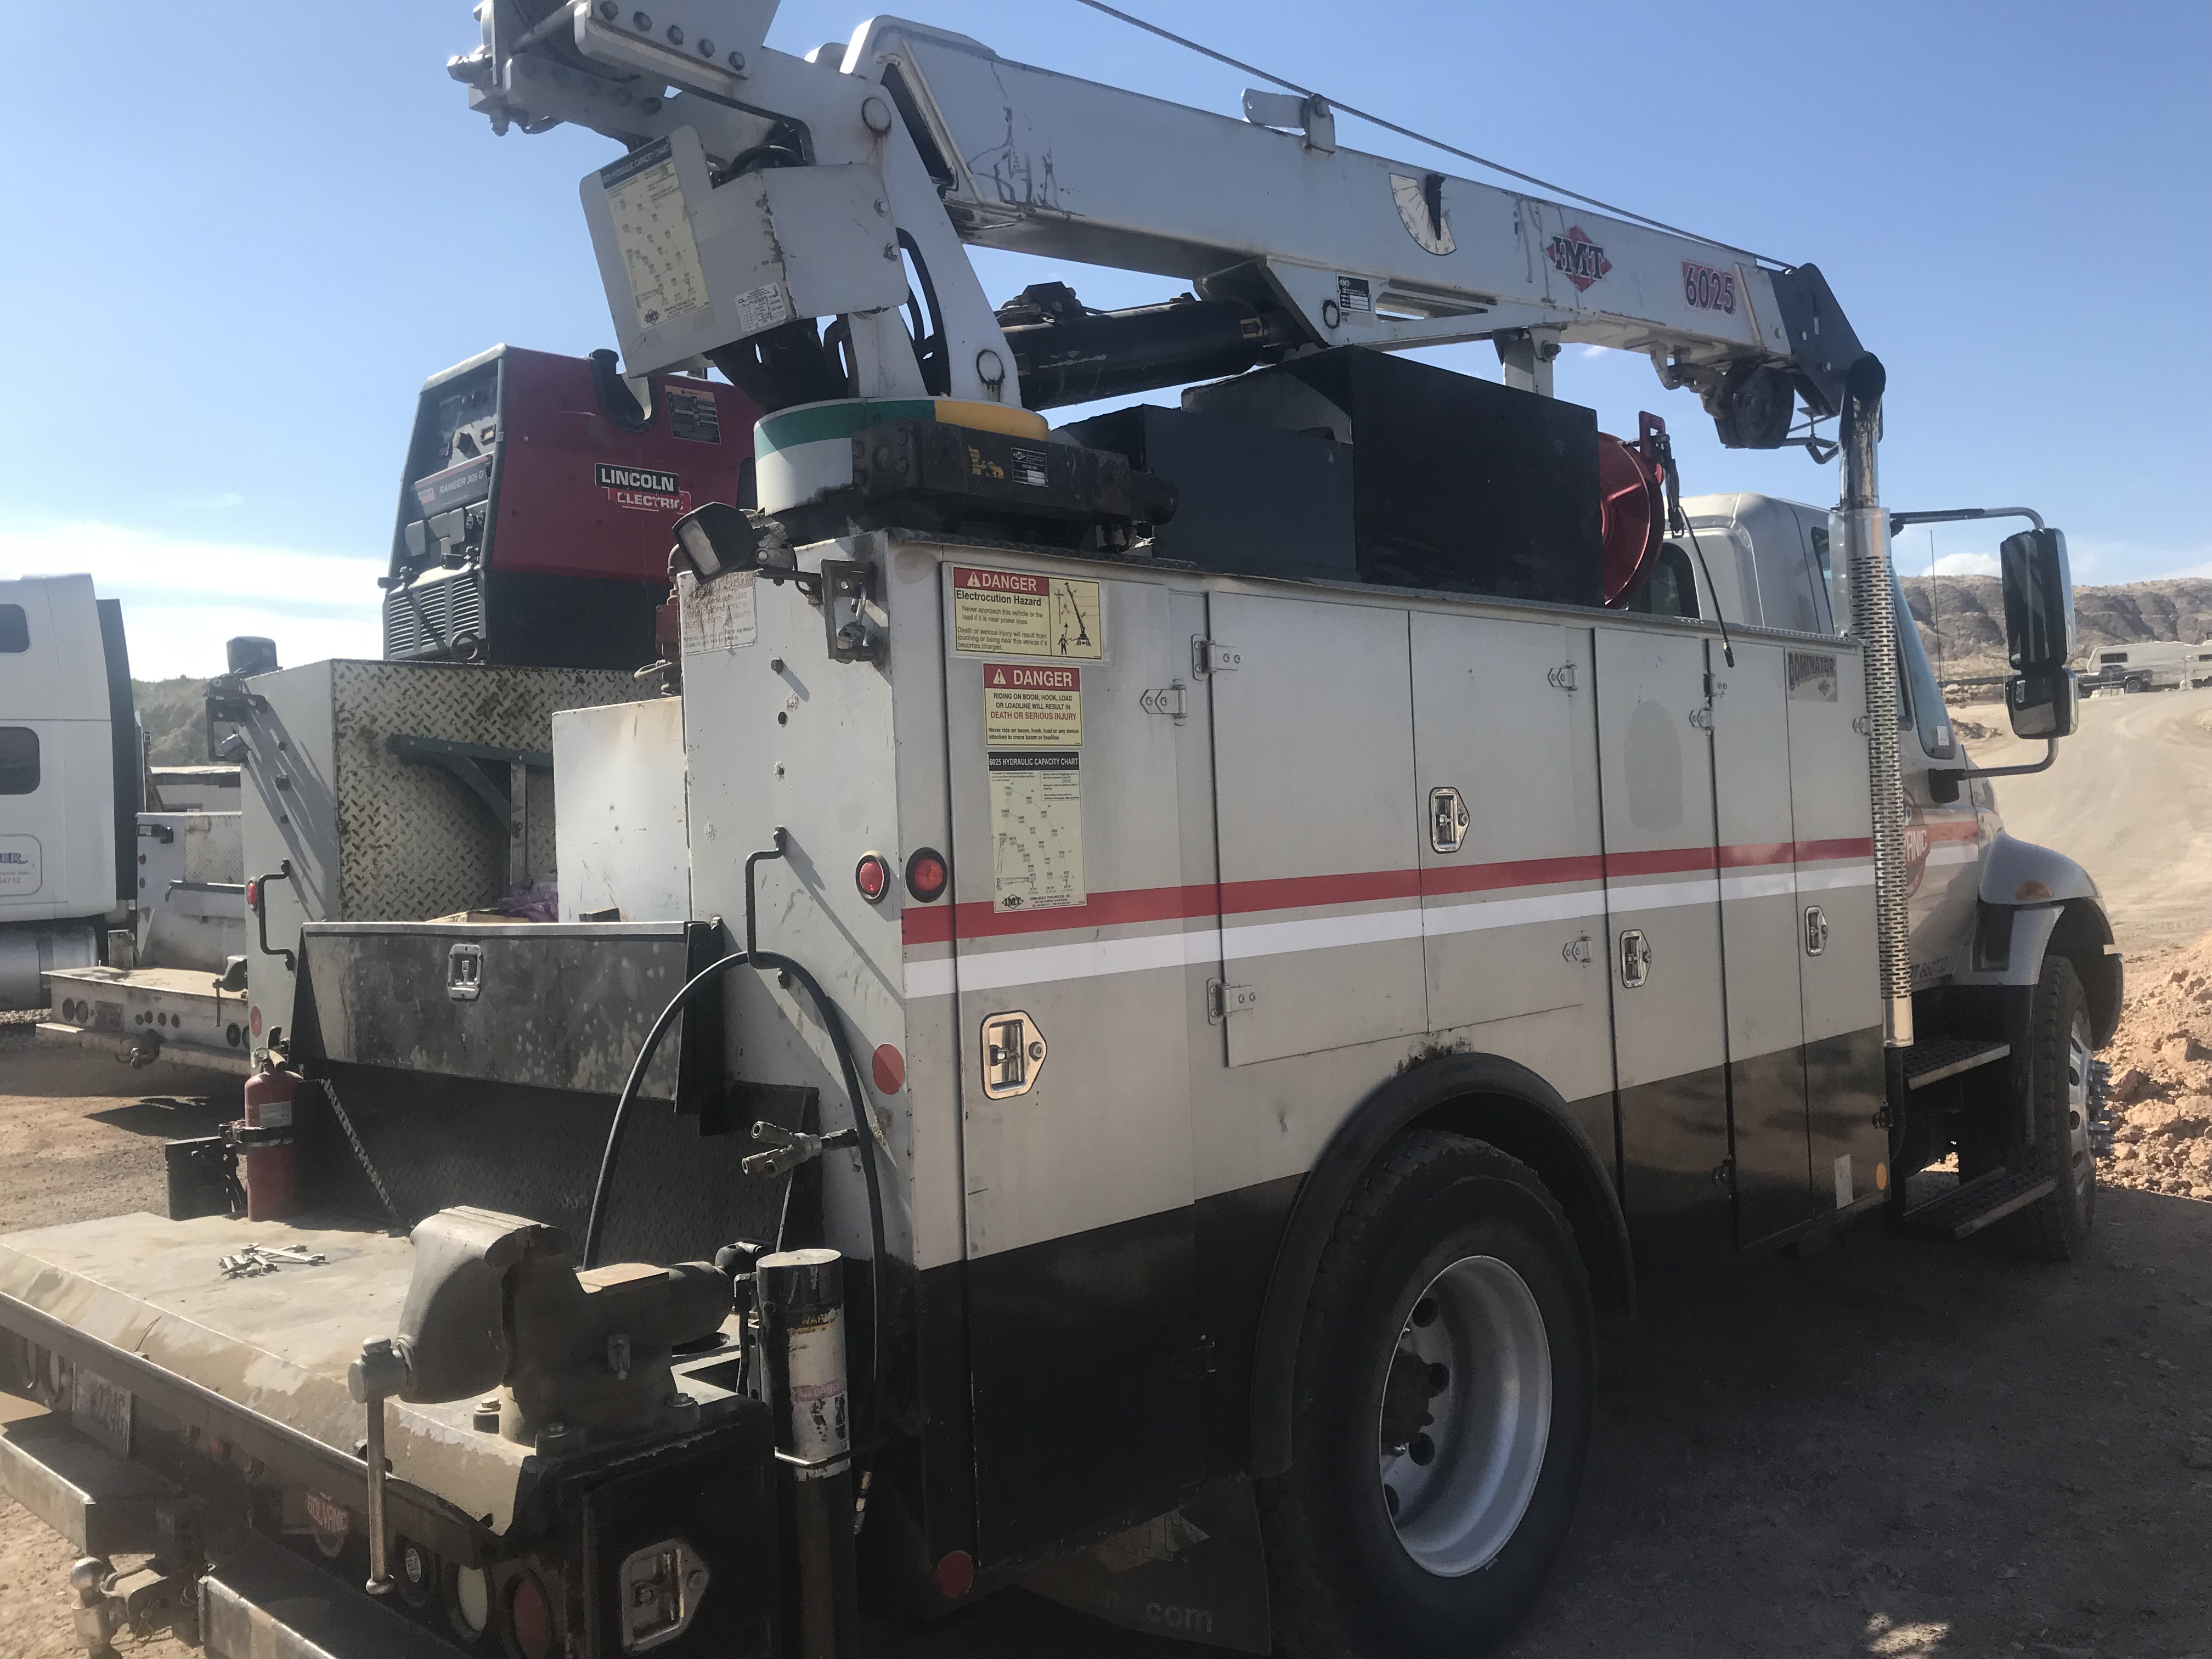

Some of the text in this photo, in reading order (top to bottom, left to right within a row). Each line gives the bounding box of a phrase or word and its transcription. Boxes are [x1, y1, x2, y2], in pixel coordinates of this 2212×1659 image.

[1552, 236, 1605, 280] IMT
[1685, 266, 1736, 315] 6025
[439, 470, 484, 494] RANGER 305 D
[601, 468, 674, 492] LINCOLN
[983, 573, 1037, 592] DANGER
[956, 590, 1041, 606] Electrocution Hazard
[958, 634, 979, 642] touching
[999, 630, 1012, 638] injury
[1013, 669, 1073, 687] DANGER
[989, 758, 1002, 766] 6025
[1905, 830, 1928, 862] ANIC
